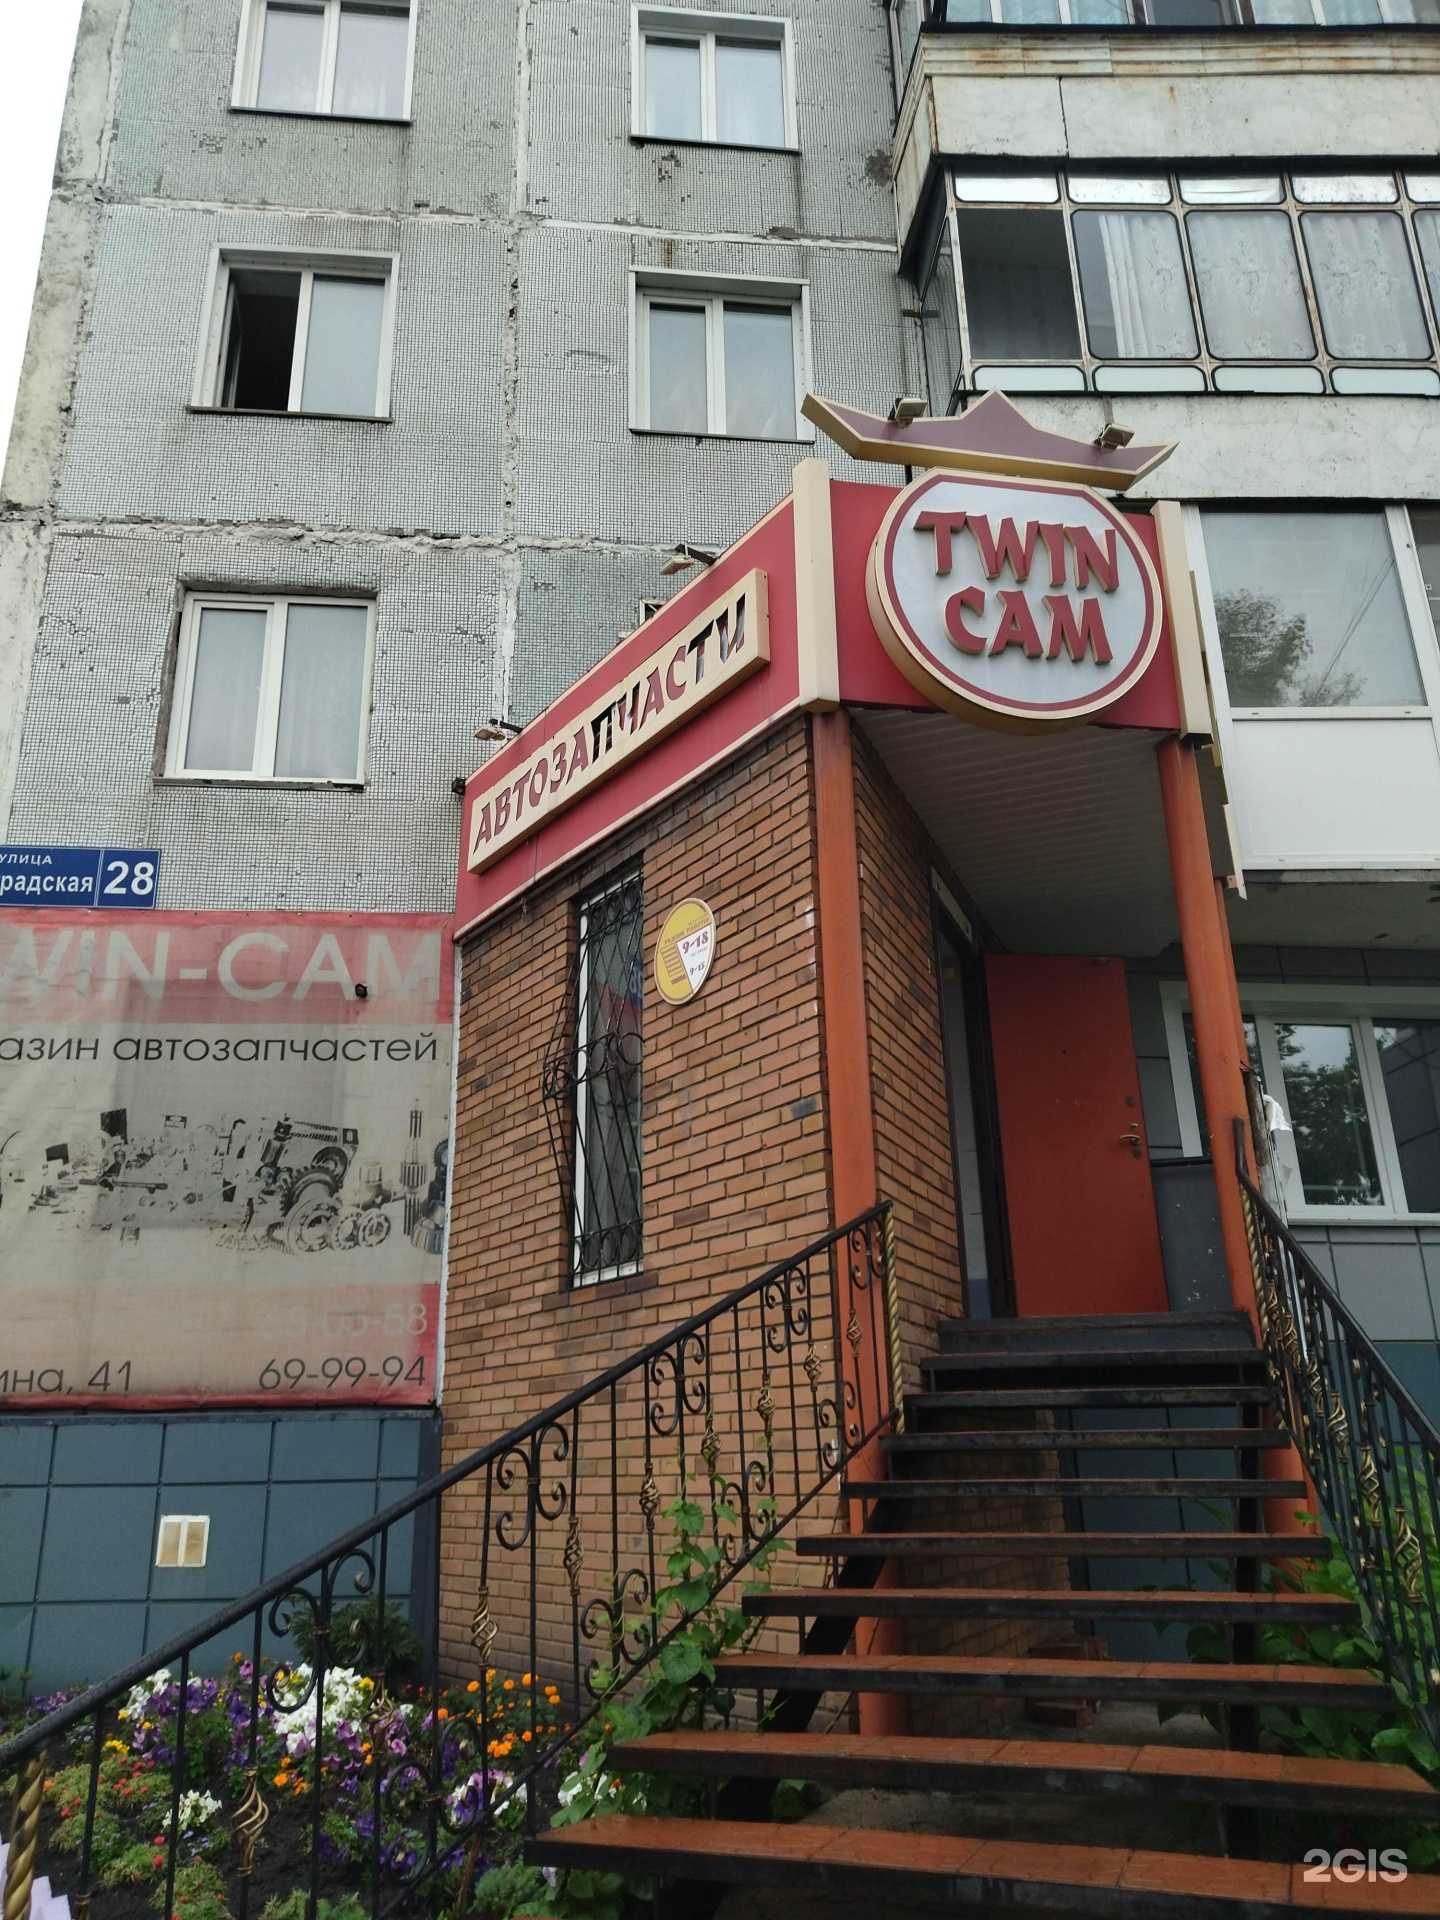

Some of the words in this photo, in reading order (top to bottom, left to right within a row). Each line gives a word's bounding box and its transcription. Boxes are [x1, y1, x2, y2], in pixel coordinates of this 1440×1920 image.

[913, 510, 1119, 593] TWIN
[944, 585, 1113, 665] CAM
[472, 592, 746, 855] АВТОЗАПЧАСТИ
[0, 874, 94, 896] радская
[103, 861, 155, 896] 28
[0, 1037, 99, 1061] азин
[113, 1032, 438, 1061] автозапчастей
[88, 1360, 131, 1393] 41
[258, 1355, 426, 1390] 69-99-94
